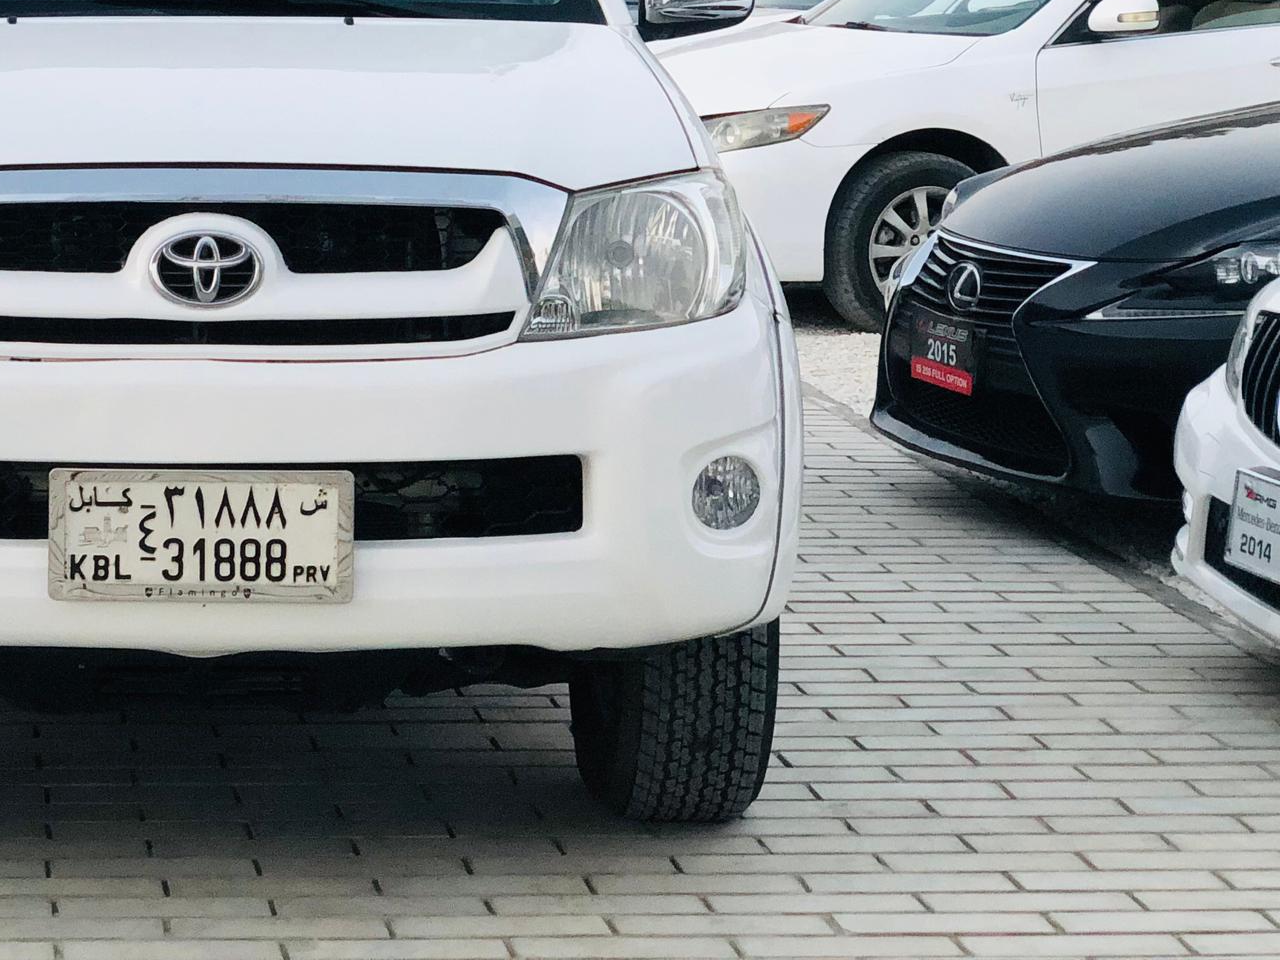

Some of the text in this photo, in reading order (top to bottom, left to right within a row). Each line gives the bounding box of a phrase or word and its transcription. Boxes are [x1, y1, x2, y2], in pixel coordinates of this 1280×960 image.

[927, 339, 957, 366] 2015
[69, 486, 133, 513] کابل
[300, 488, 328, 516] ش
[69, 537, 330, 583] KBL 31888 PRV
[1240, 533, 1272, 563] 2014
[158, 588, 240, 598] Flamingo
